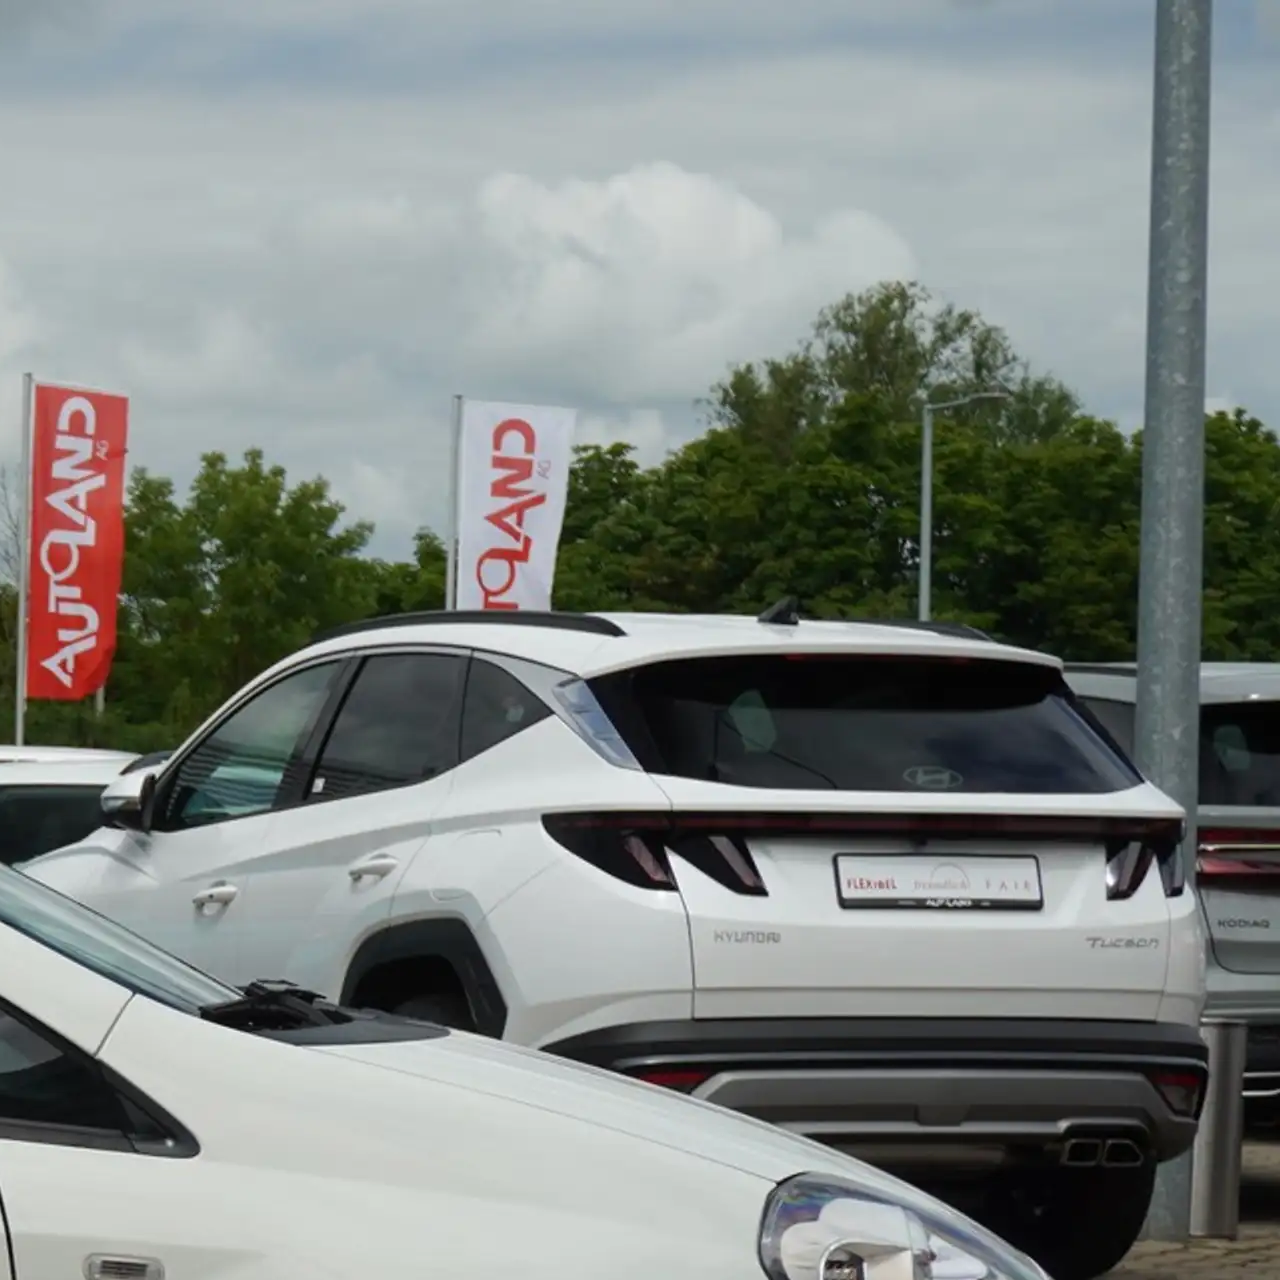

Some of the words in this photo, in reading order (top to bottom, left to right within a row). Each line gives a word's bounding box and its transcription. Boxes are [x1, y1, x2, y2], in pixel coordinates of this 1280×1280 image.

[41, 396, 107, 688] AUTOLAND
[476, 418, 546, 611] TOLAND
[713, 930, 782, 944] HYUNDAI
[1217, 918, 1271, 930] KODIAQ
